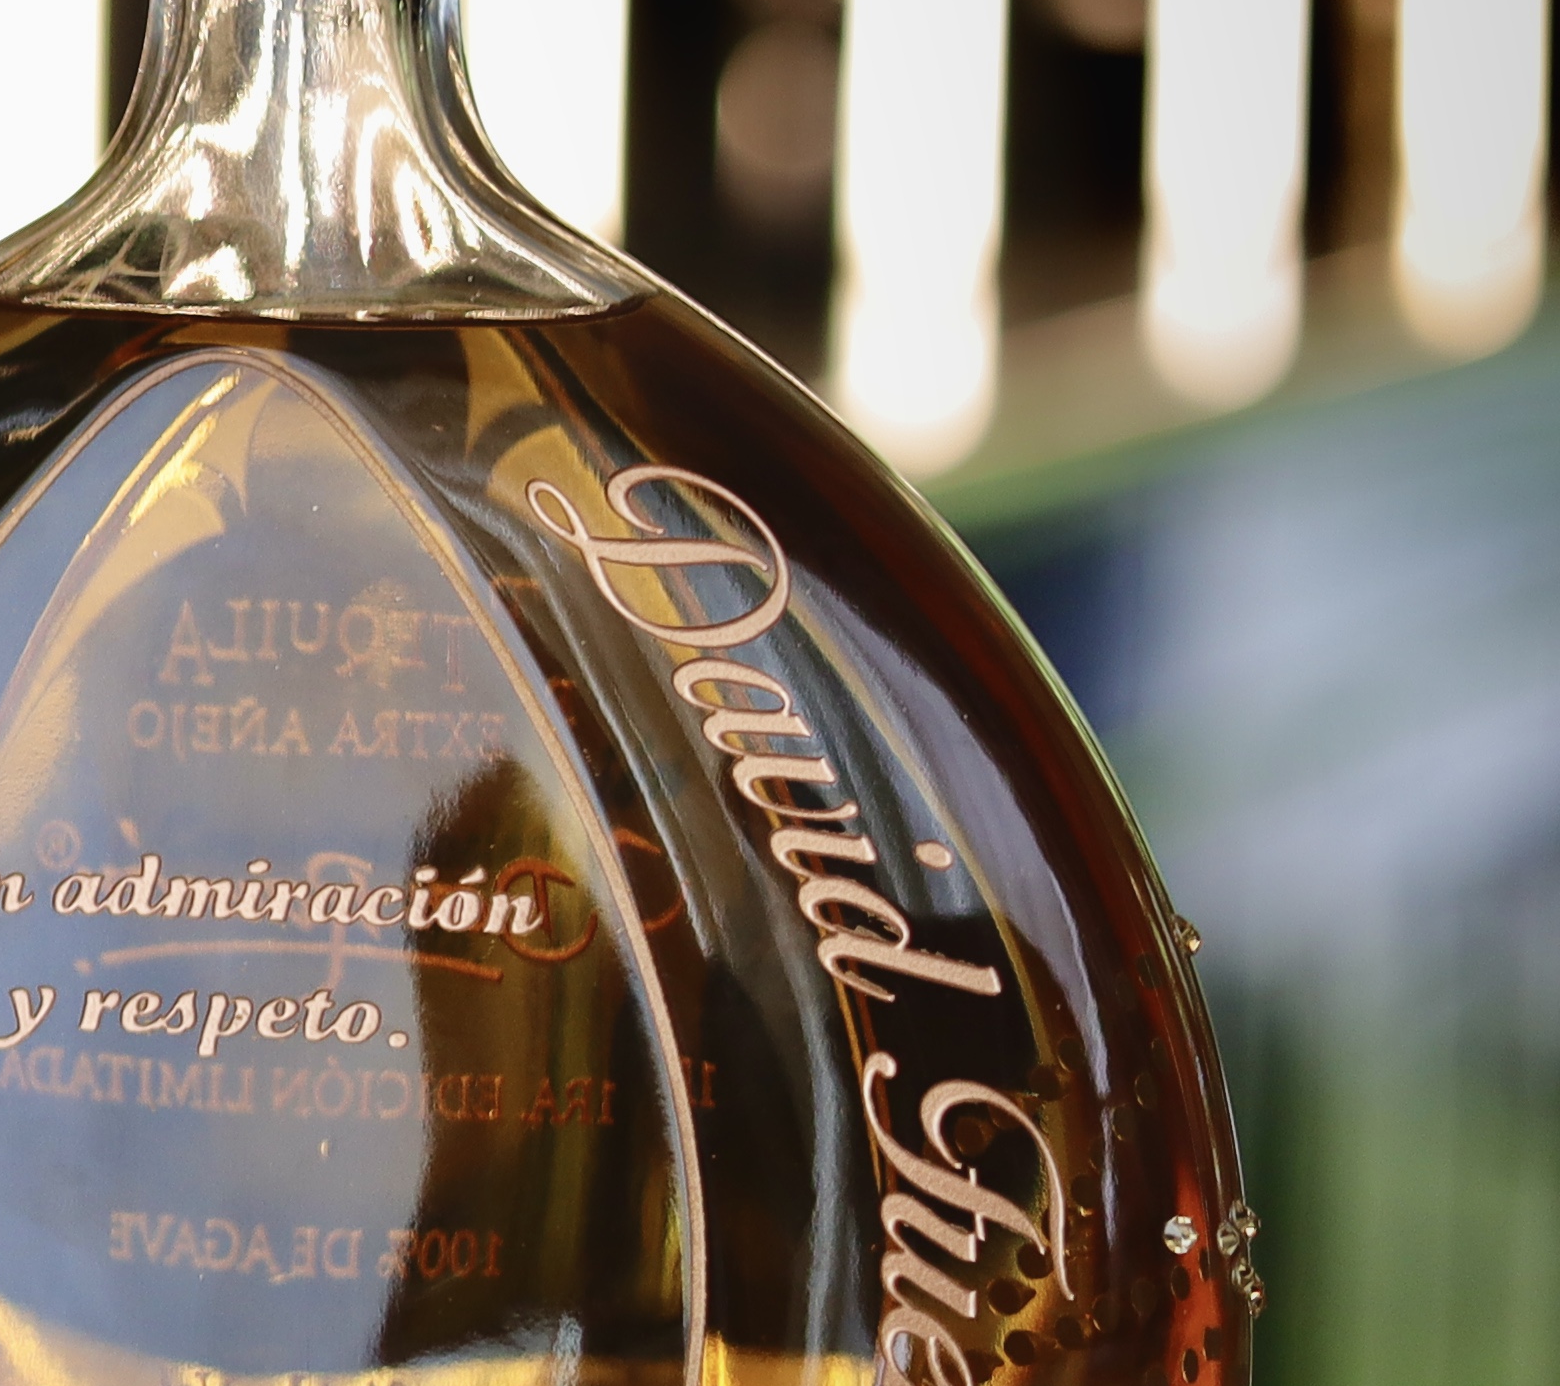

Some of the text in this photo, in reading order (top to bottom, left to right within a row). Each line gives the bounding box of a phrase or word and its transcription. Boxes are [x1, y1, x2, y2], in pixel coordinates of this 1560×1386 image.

[525, 462, 1003, 1006] David
[52, 853, 542, 939] admiración
[77, 982, 412, 1059] respeto.
